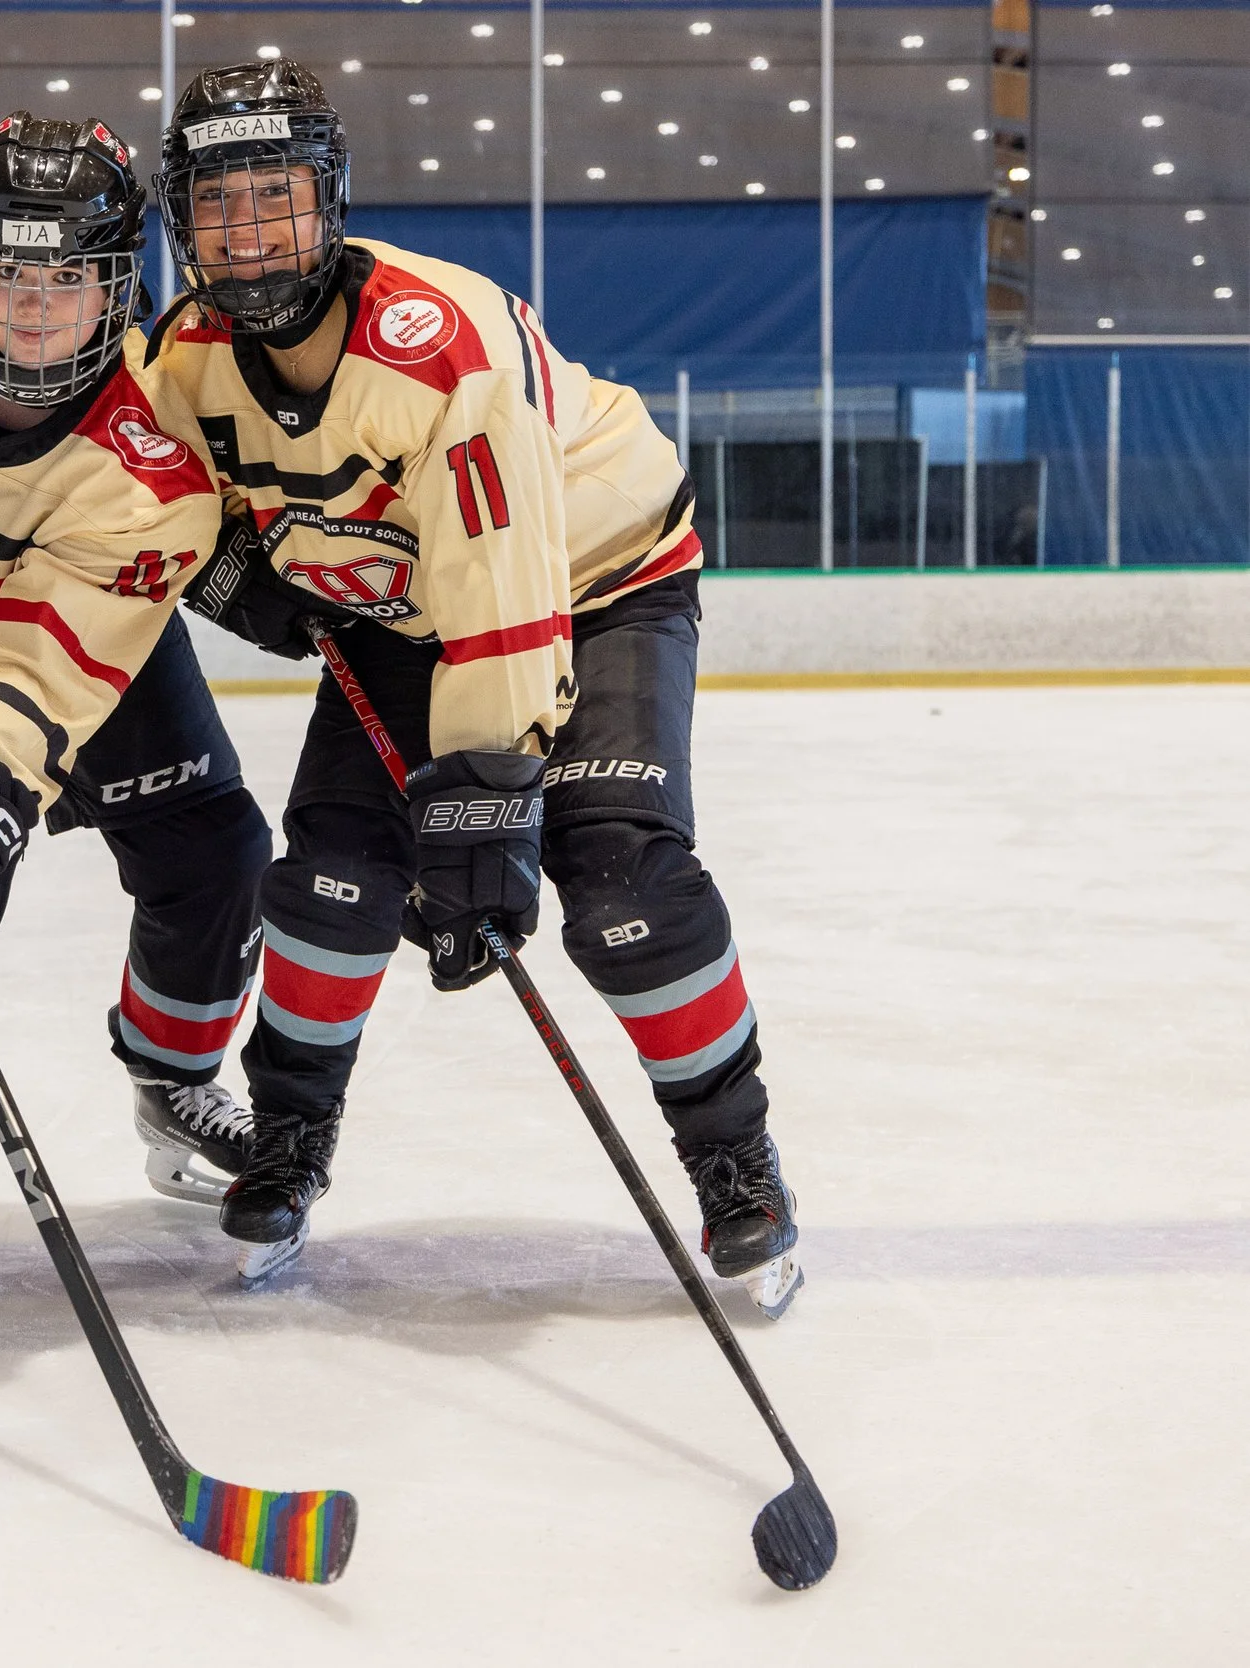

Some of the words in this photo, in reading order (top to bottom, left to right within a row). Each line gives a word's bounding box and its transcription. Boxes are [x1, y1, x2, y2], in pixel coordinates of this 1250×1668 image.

[192, 118, 282, 144] TEAGAN
[12, 224, 49, 243] TIA
[394, 310, 435, 341] Jumpstart
[398, 331, 416, 346] Bon
[446, 432, 510, 539] 11
[344, 524, 372, 535] OUT
[375, 528, 419, 552] SOCIETY
[100, 753, 210, 804] CCM
[314, 874, 360, 903] BD
[601, 919, 650, 947] BD
